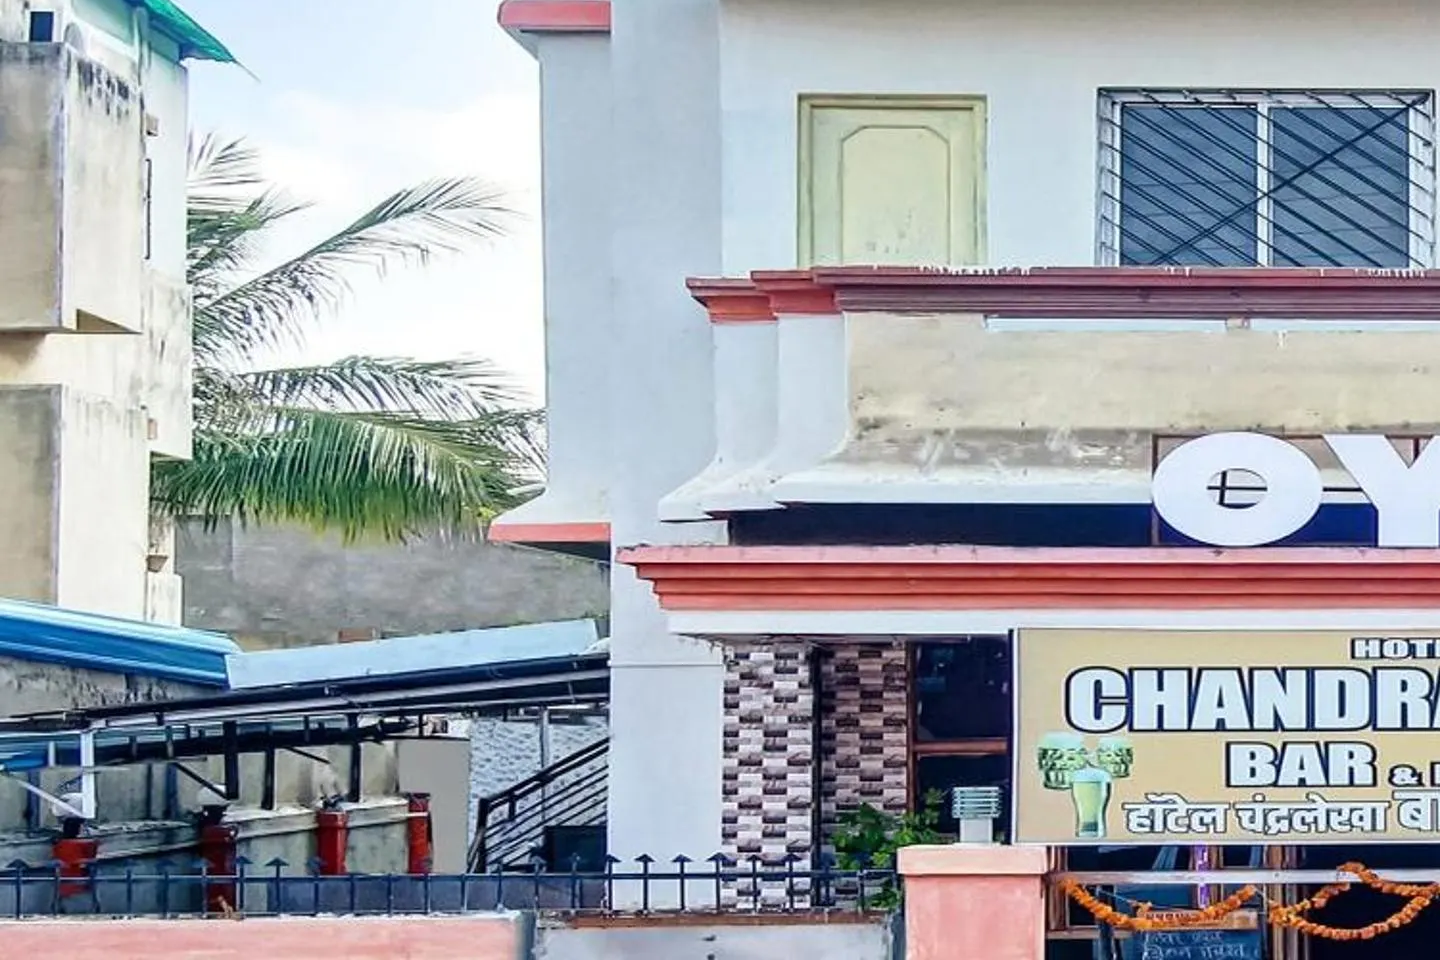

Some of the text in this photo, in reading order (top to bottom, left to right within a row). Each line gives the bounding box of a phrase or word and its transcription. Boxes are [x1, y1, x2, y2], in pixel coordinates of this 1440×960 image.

[1225, 740, 1379, 788] BAR
[1388, 763, 1424, 787] &
[1122, 792, 1231, 833] हॉटेल
